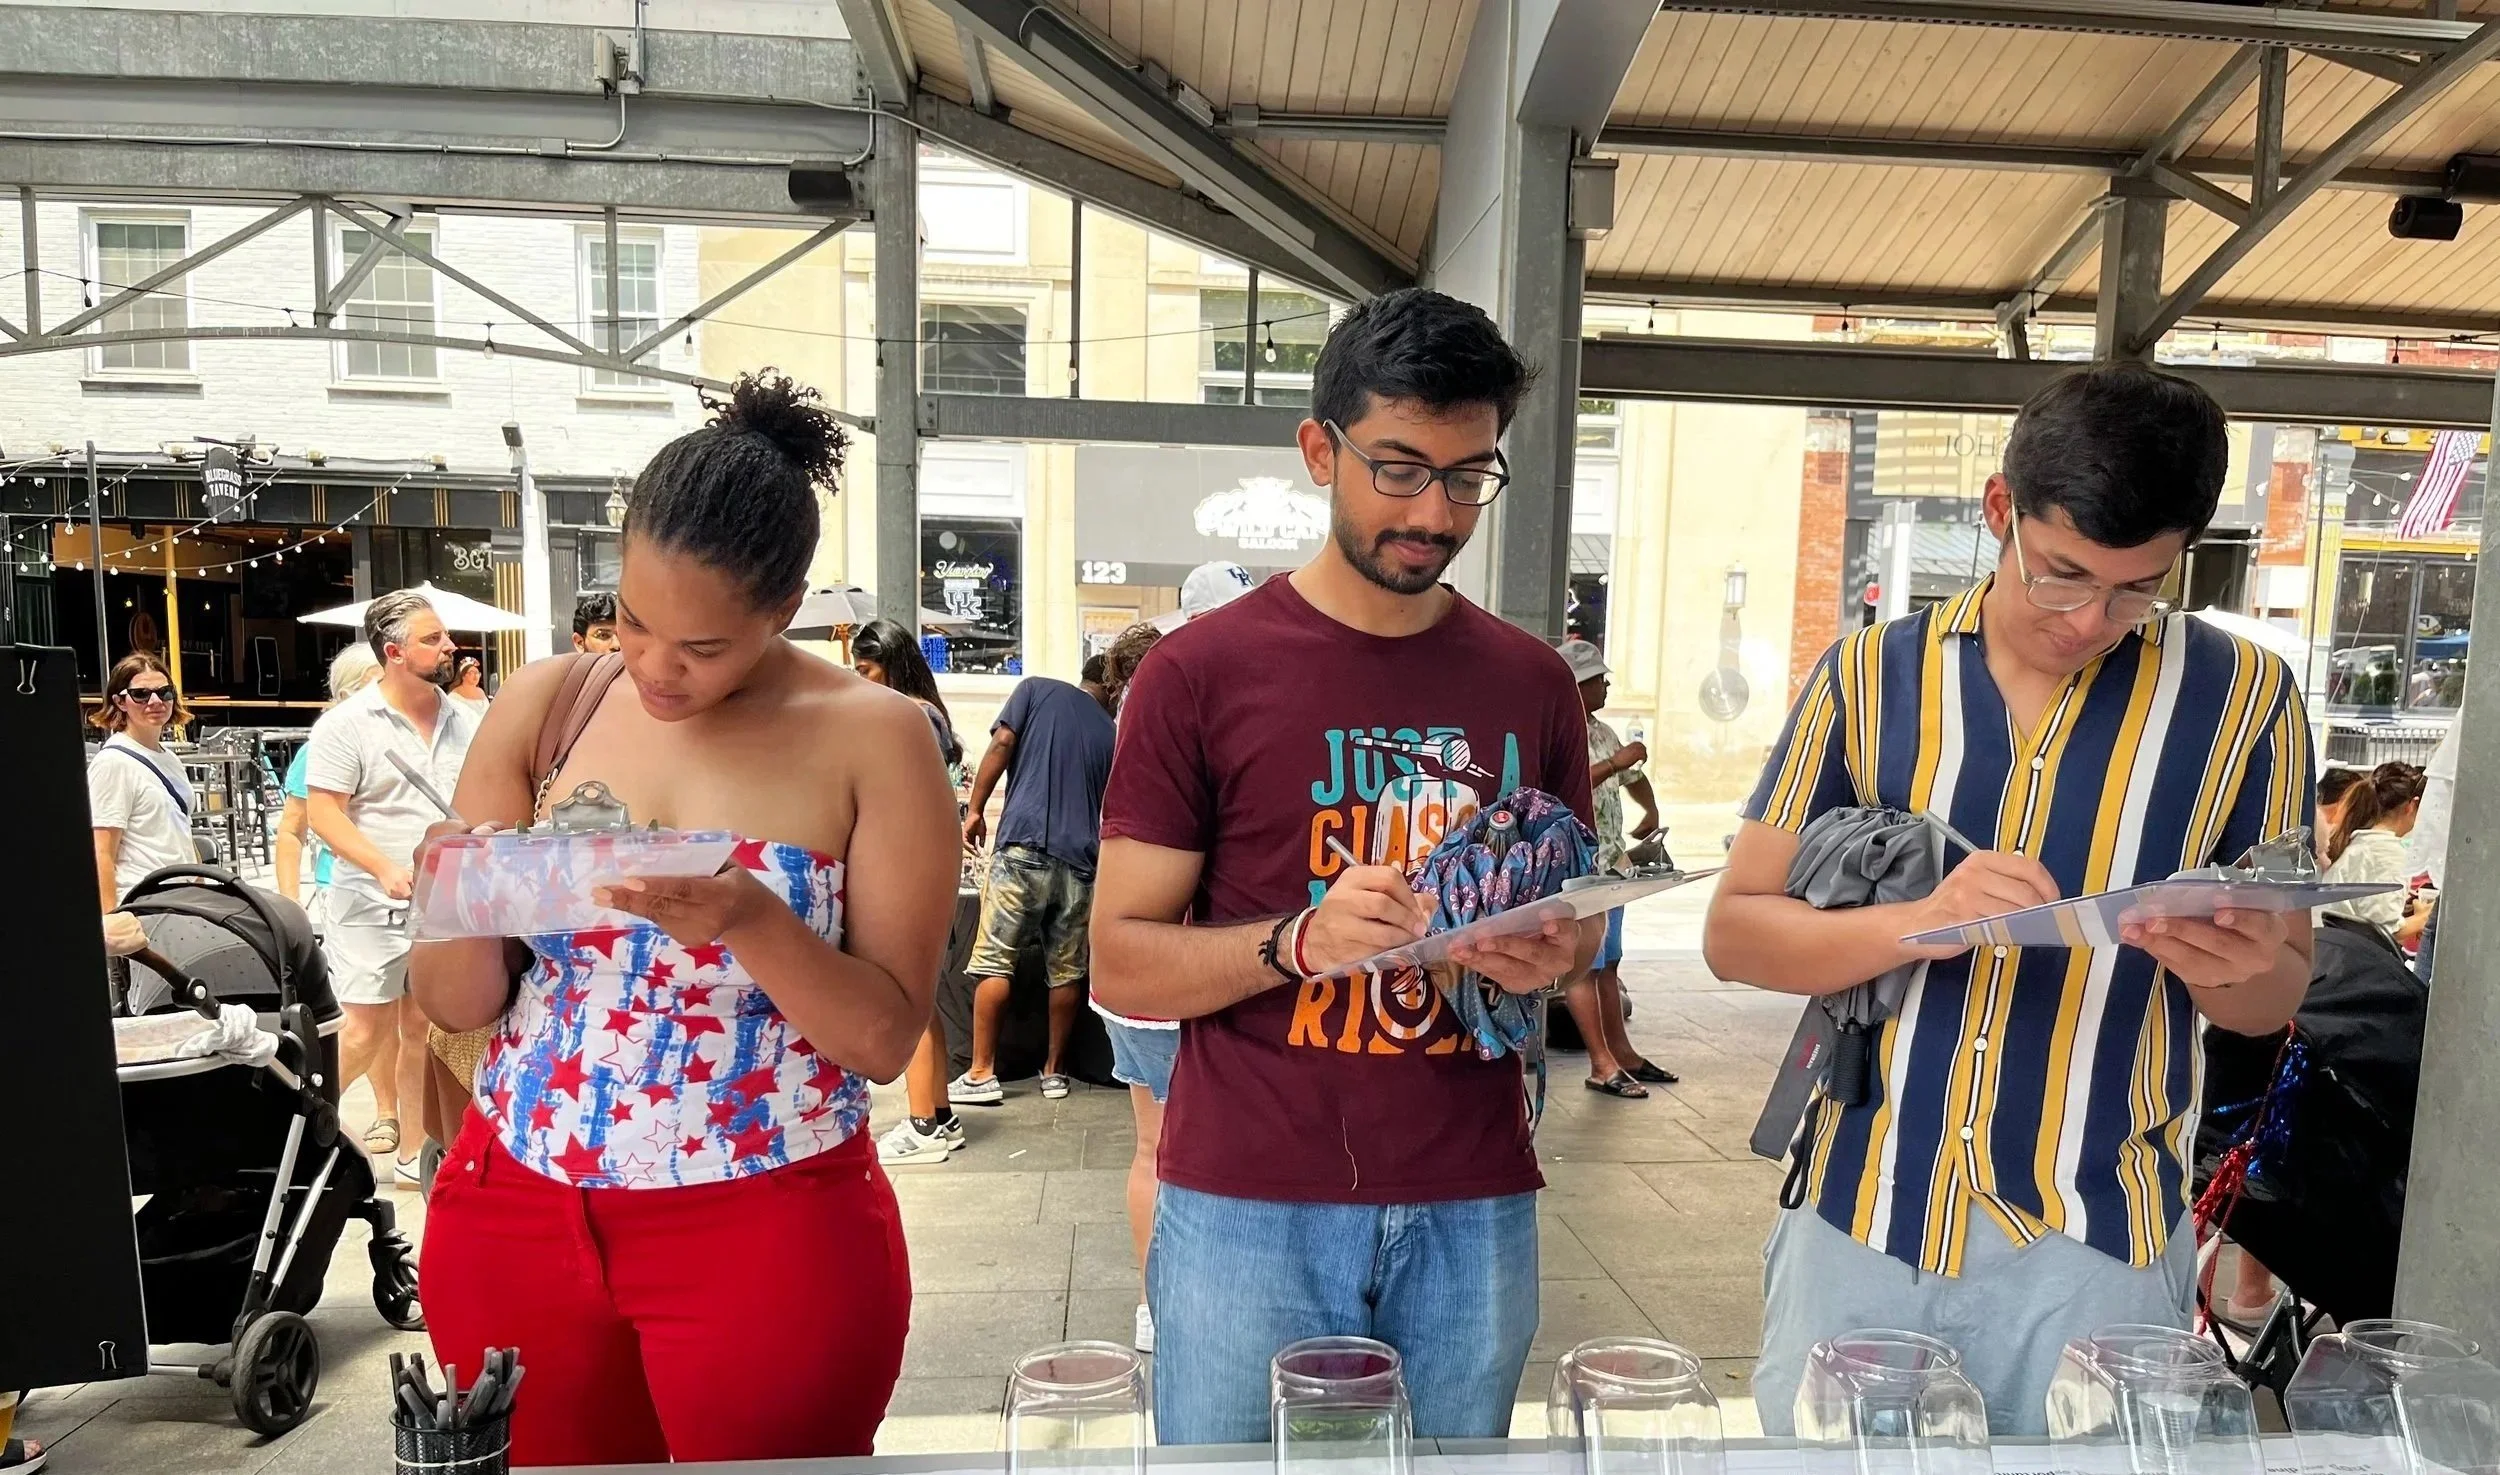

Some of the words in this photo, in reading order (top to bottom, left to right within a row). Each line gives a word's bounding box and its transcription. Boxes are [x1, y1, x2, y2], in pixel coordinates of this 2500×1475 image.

[1943, 433, 1997, 460] JOH
[205, 468, 242, 487] BLUEGRASS
[209, 483, 240, 500] TAVERN
[1238, 538, 1299, 550] SALOON
[1081, 560, 1127, 584] 123
[944, 588, 983, 619] UK
[1311, 726, 1465, 806] JUST
[1497, 732, 1521, 802] A
[1309, 803, 1477, 877] CLAS
